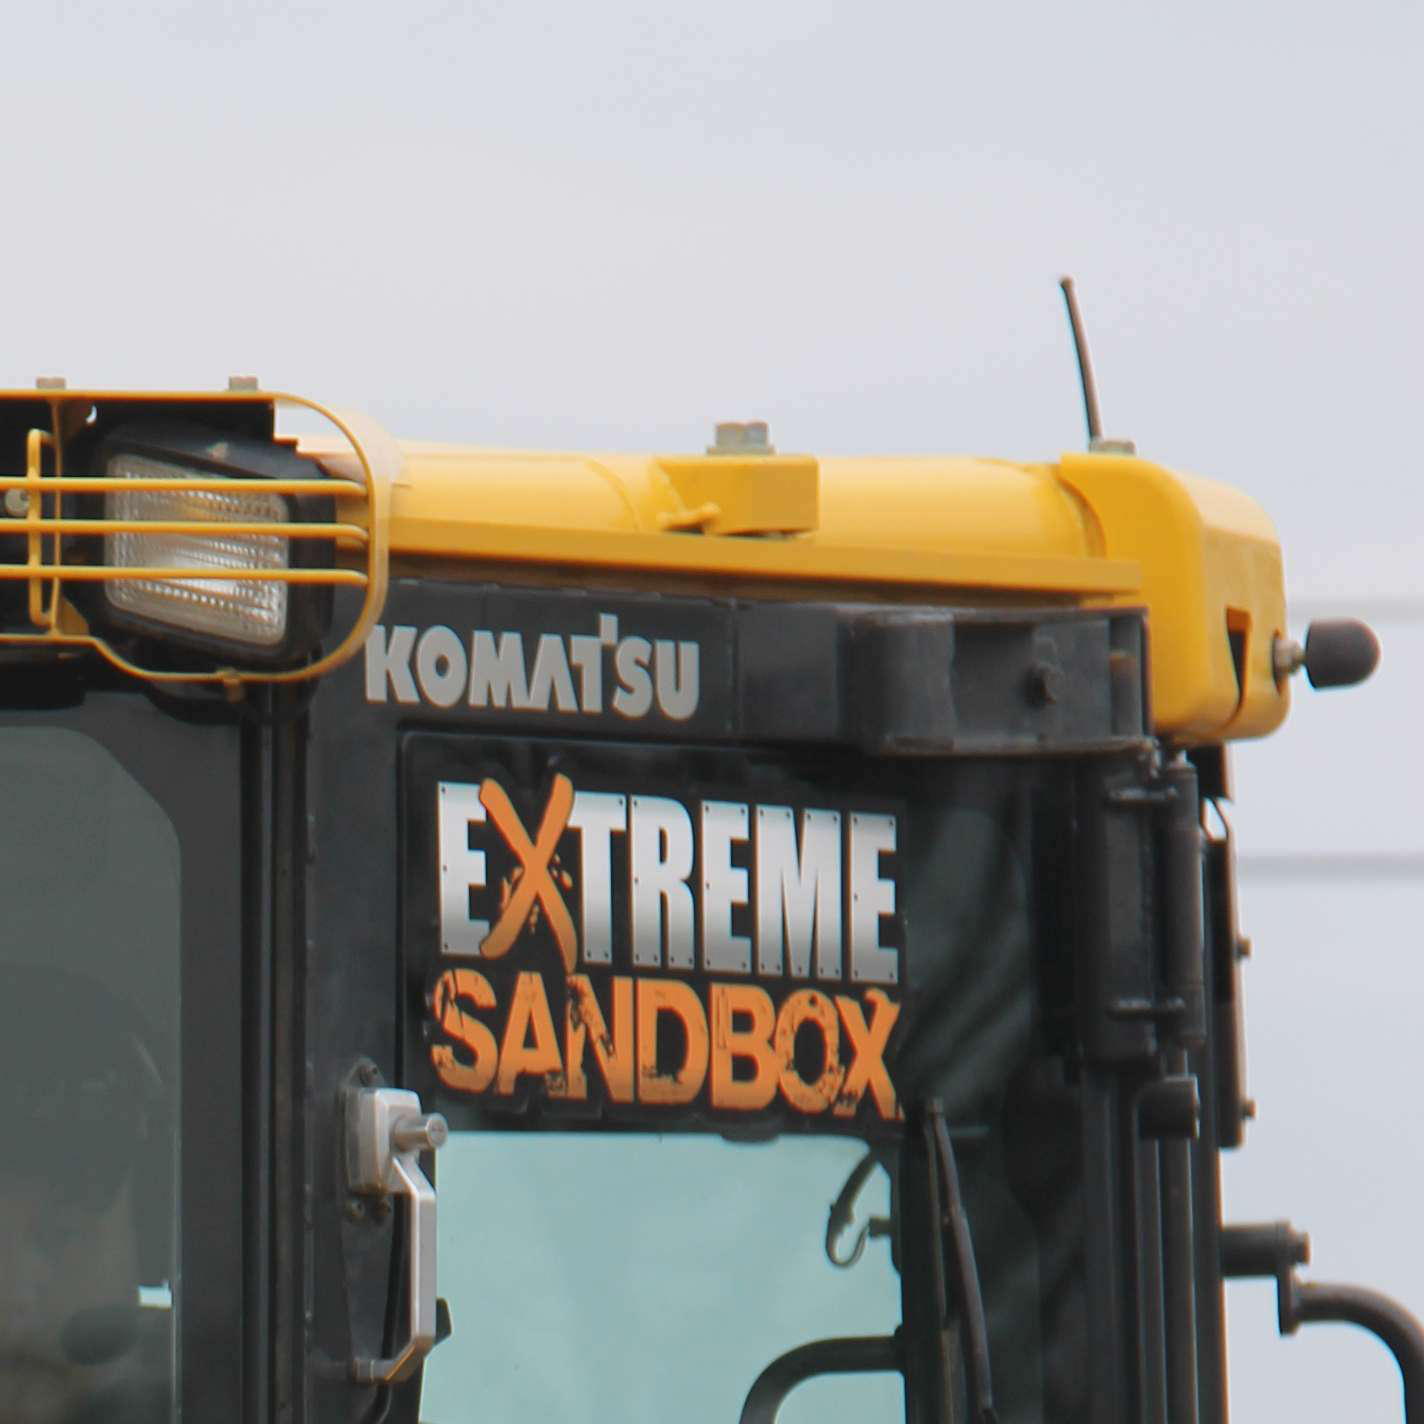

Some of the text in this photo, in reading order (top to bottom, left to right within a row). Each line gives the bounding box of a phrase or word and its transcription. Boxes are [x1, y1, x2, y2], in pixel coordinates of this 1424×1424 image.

[365, 613, 700, 720] KOMATSU
[436, 773, 899, 984] EXTREME
[430, 968, 905, 1121] SANDBOX
